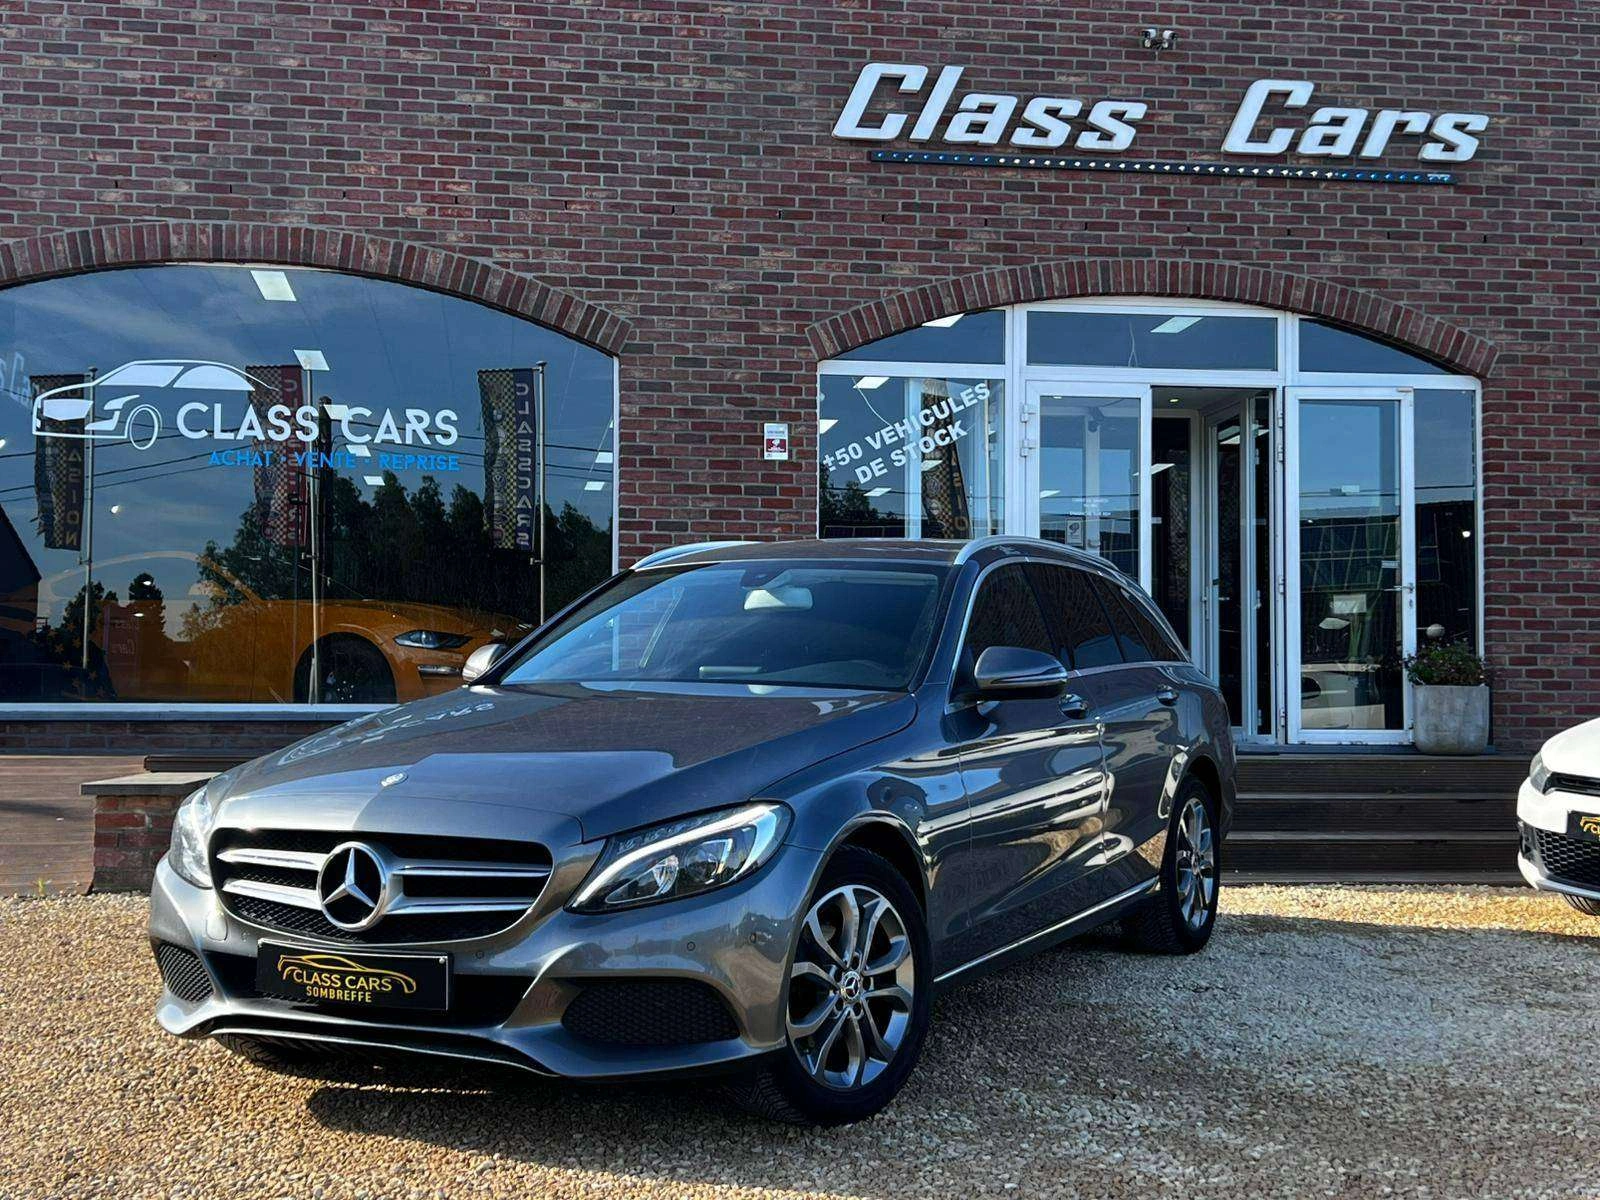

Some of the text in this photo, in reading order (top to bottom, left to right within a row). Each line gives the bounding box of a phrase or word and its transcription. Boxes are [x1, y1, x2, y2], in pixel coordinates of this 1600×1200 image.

[831, 61, 1491, 164] Class Cars
[176, 401, 459, 446] CLASS CARS
[865, 382, 991, 450] VEHICULES
[208, 451, 461, 472] ACHAT VENTE REPRISE
[854, 419, 968, 485] DE STOCK
[293, 969, 392, 991] CLASS CARS
[306, 986, 372, 1003] SOMBREFFE
